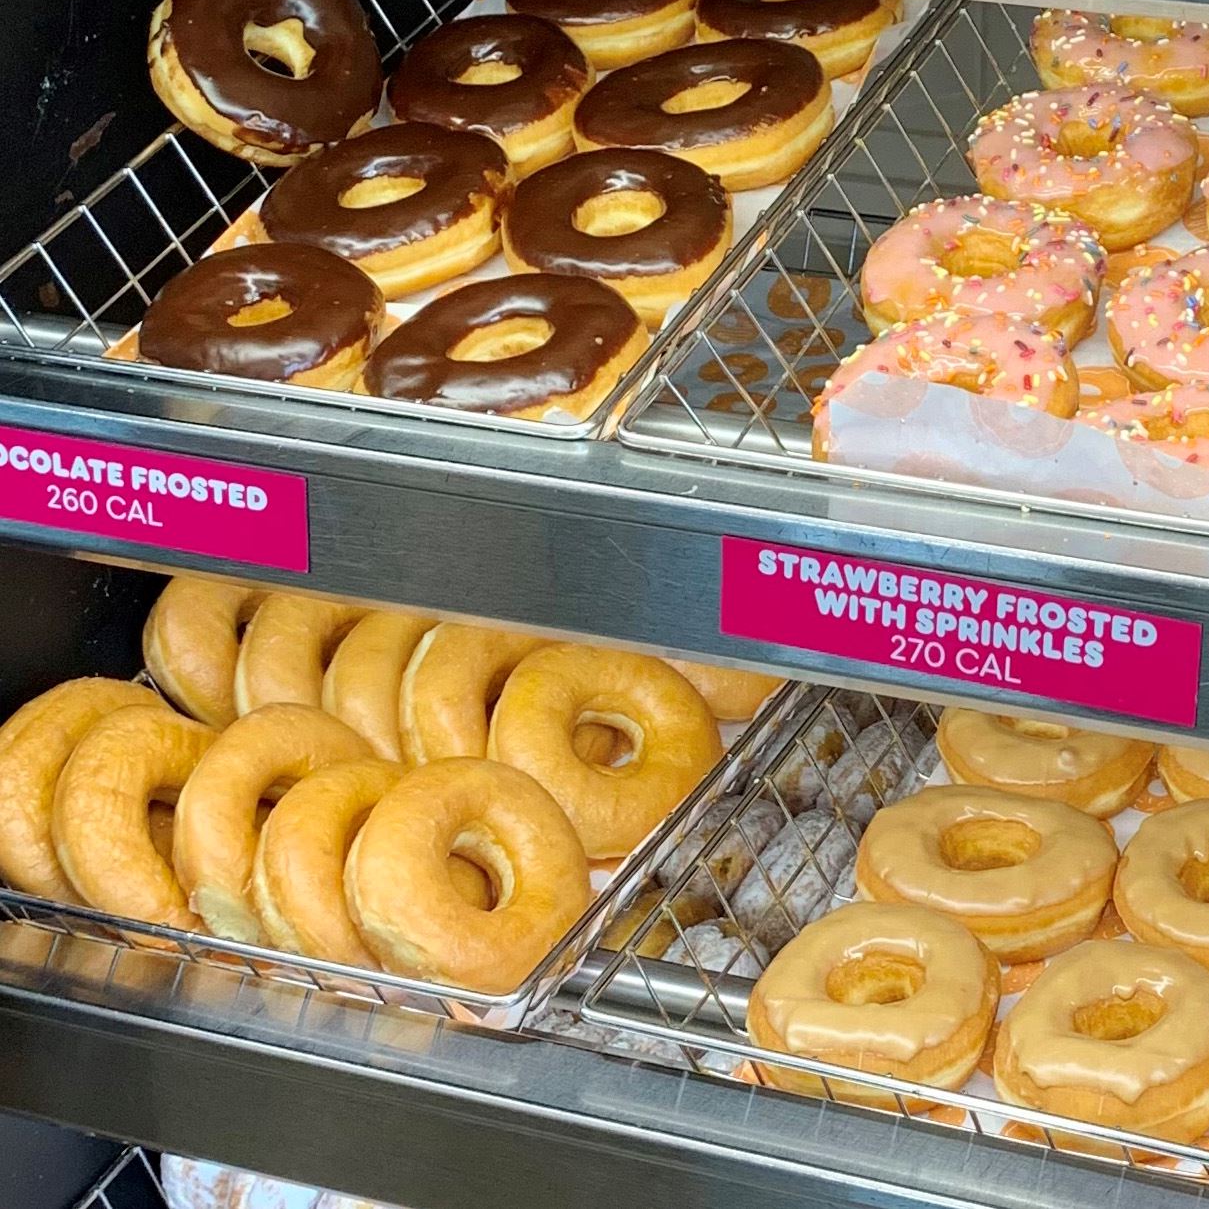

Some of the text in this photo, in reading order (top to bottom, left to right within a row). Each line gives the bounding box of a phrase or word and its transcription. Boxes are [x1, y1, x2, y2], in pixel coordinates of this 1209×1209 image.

[47, 484, 163, 527] 260 CAL
[131, 466, 268, 511] FROSTED
[757, 548, 1158, 647] STRAWBERRY FROSTED
[814, 588, 1104, 668] WITH SPRINKLES
[890, 635, 1021, 684] 270 CAL
